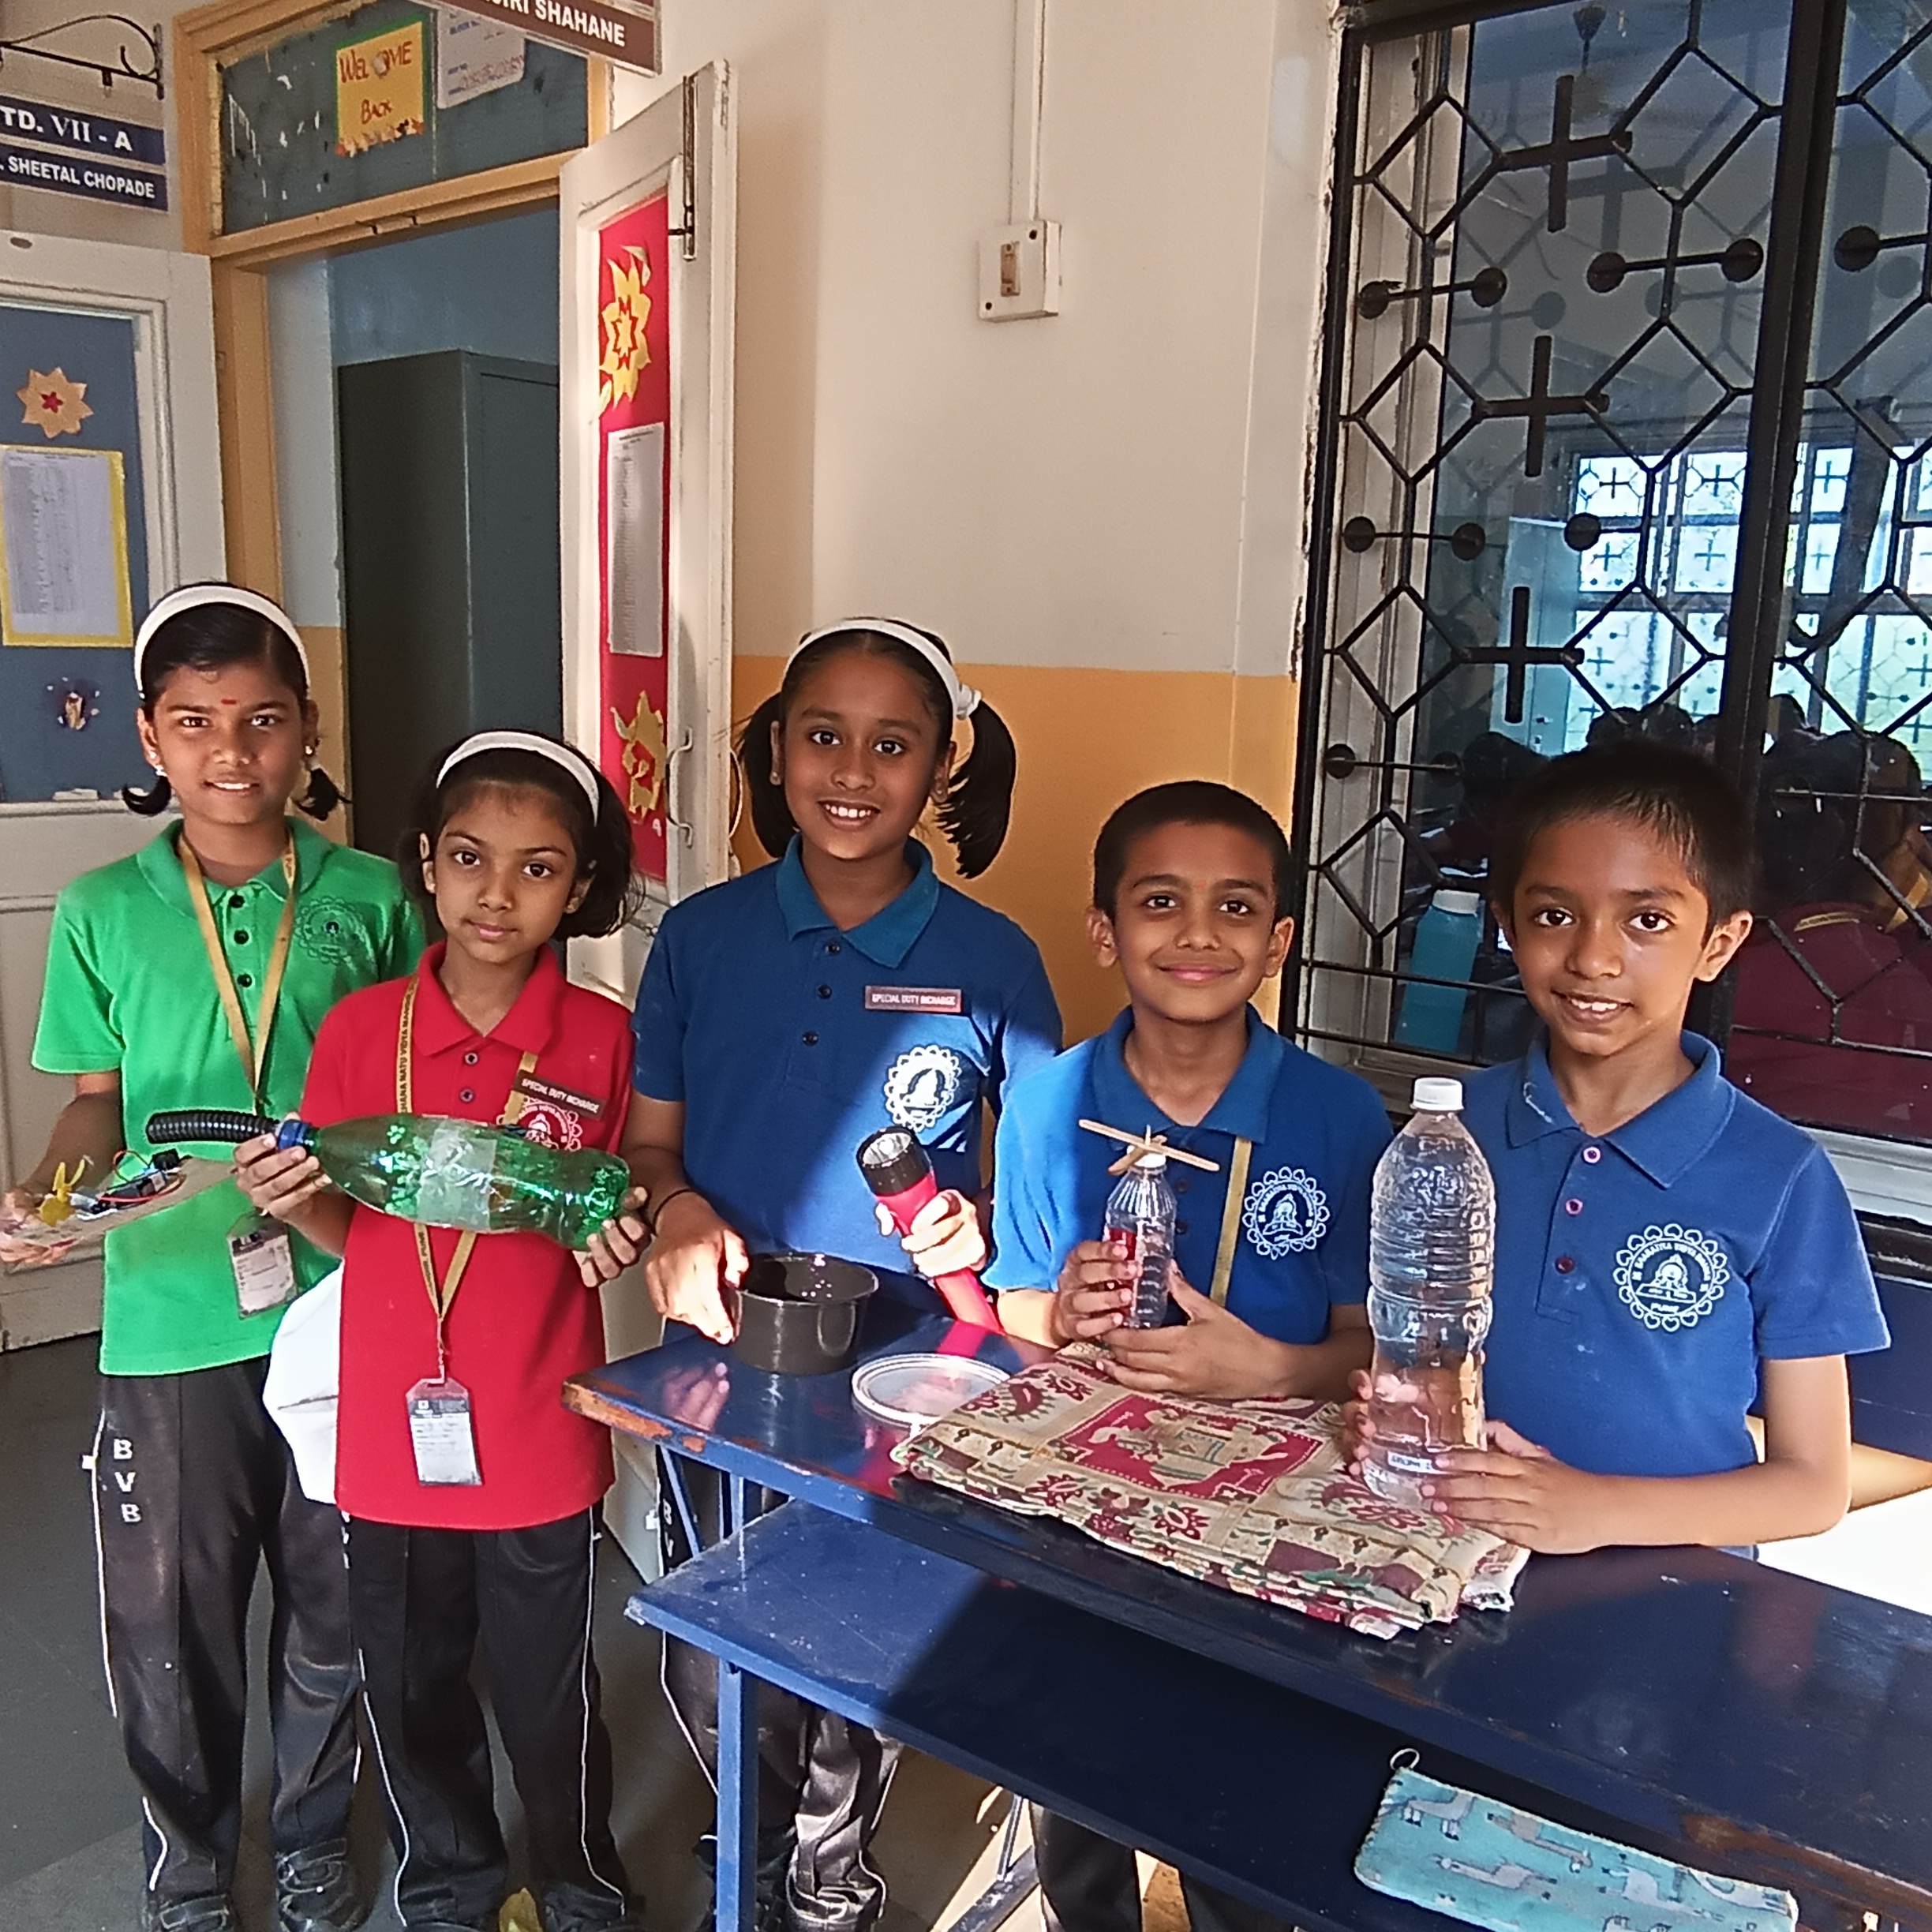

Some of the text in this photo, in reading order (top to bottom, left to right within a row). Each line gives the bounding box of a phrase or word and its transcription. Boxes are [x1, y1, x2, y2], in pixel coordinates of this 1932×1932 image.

[534, 0, 625, 47] SHAHANE
[339, 40, 413, 84] WELOME
[50, 114, 92, 143] VII
[114, 130, 133, 152] A
[8, 155, 155, 199] SHEETAL CHOPADE
